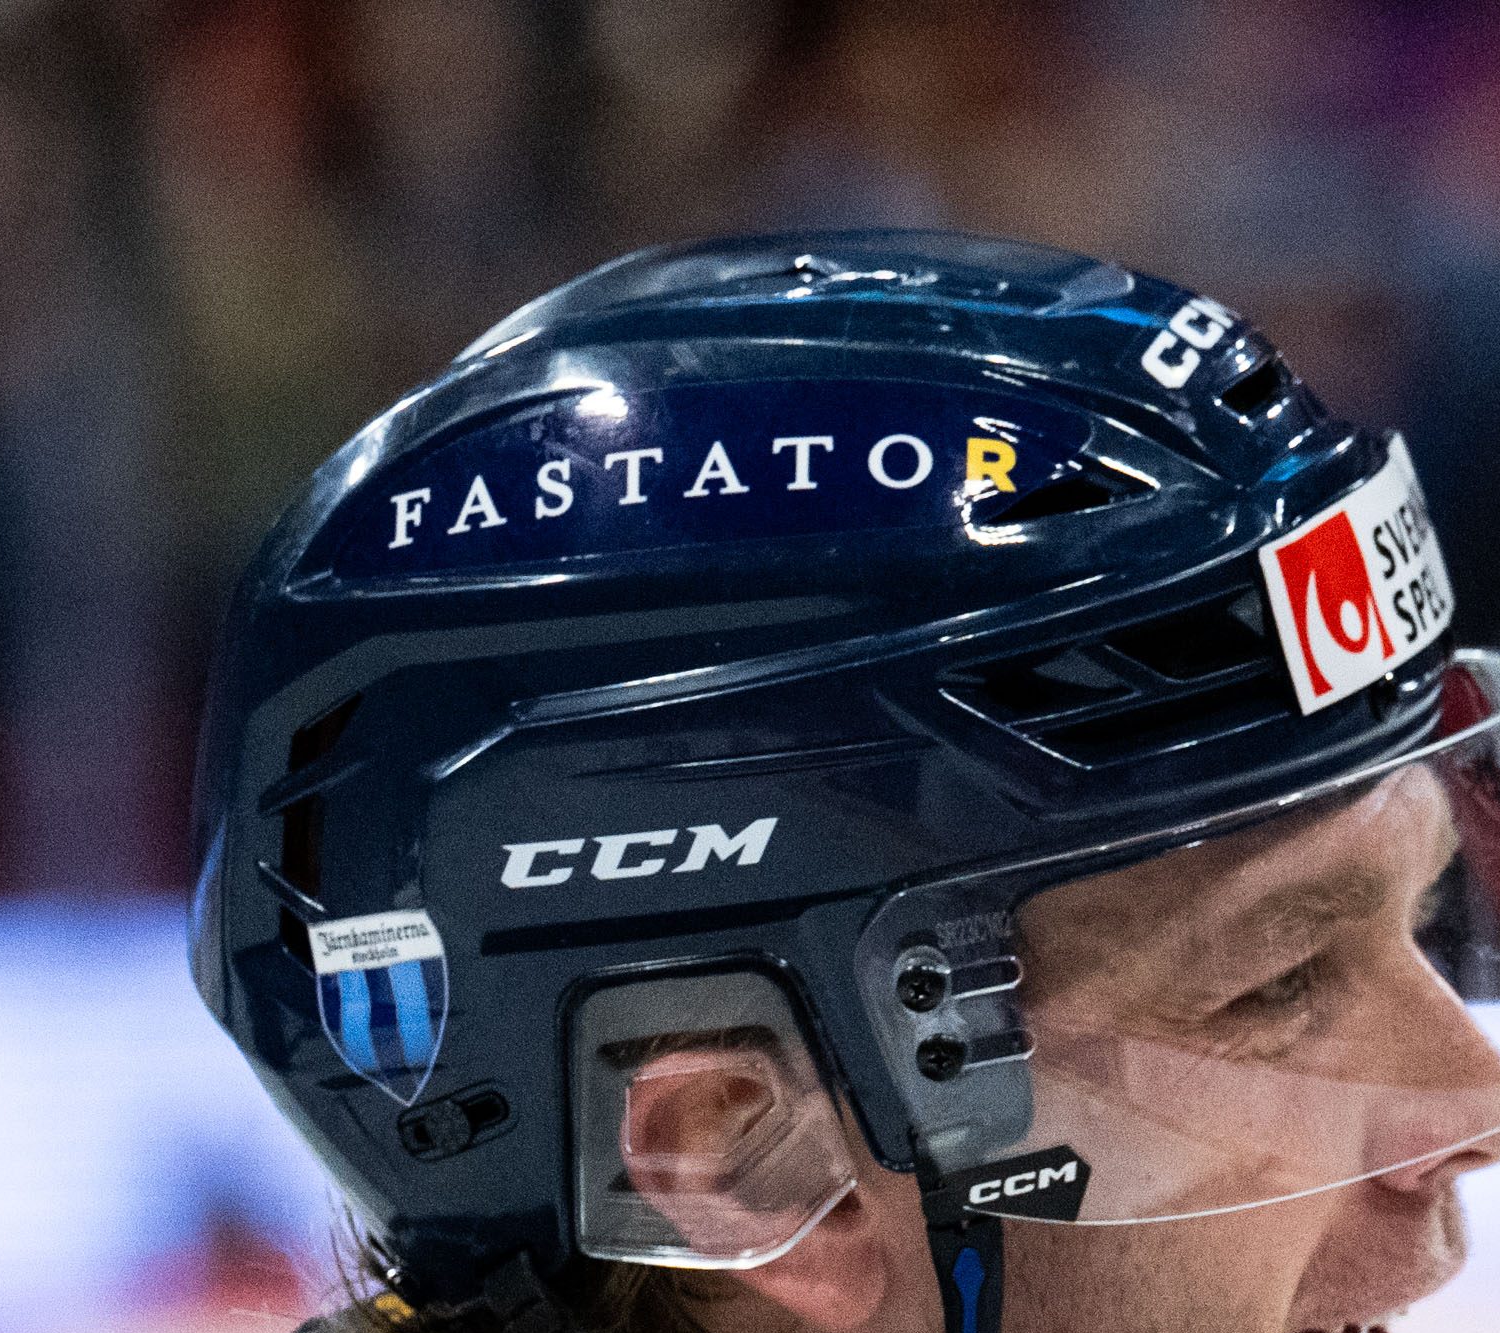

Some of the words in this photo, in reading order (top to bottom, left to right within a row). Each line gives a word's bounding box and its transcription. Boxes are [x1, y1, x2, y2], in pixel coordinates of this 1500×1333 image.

[388, 433, 1017, 549] FASTATOR
[500, 817, 779, 889] CCM
[969, 1160, 1078, 1204] CCM
